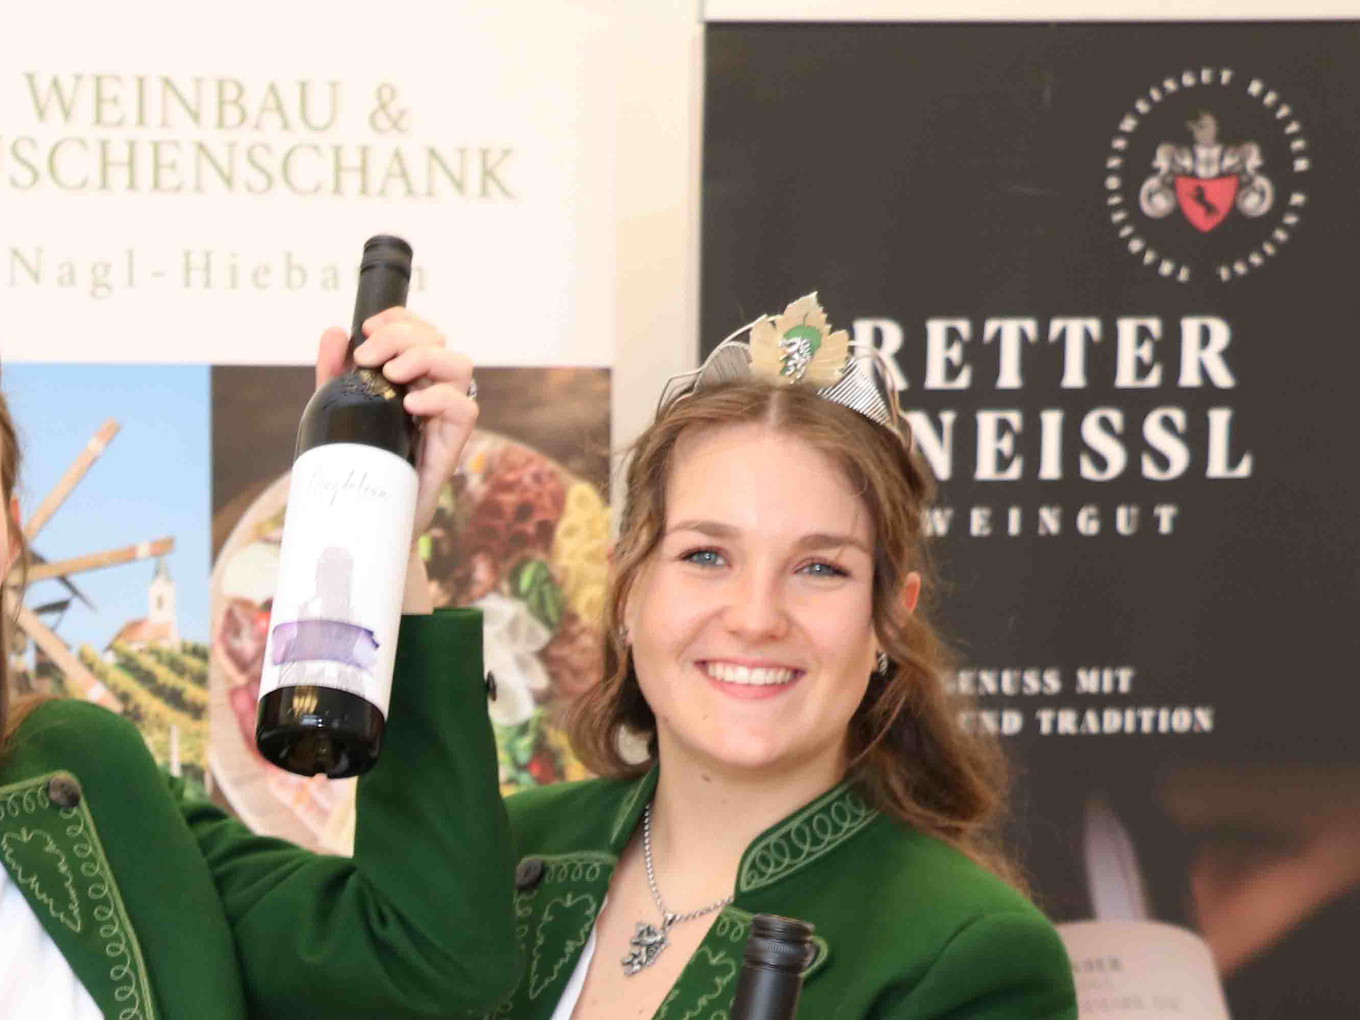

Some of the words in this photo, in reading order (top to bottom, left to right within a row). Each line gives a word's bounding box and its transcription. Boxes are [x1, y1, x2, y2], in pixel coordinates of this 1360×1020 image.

[23, 70, 342, 135] WEINBAU
[368, 81, 412, 136] &
[851, 315, 1238, 391] RETTER
[923, 503, 1179, 538] WEINGUT
[1076, 666, 1137, 696] MIT
[1035, 706, 1216, 736] TRADITION
